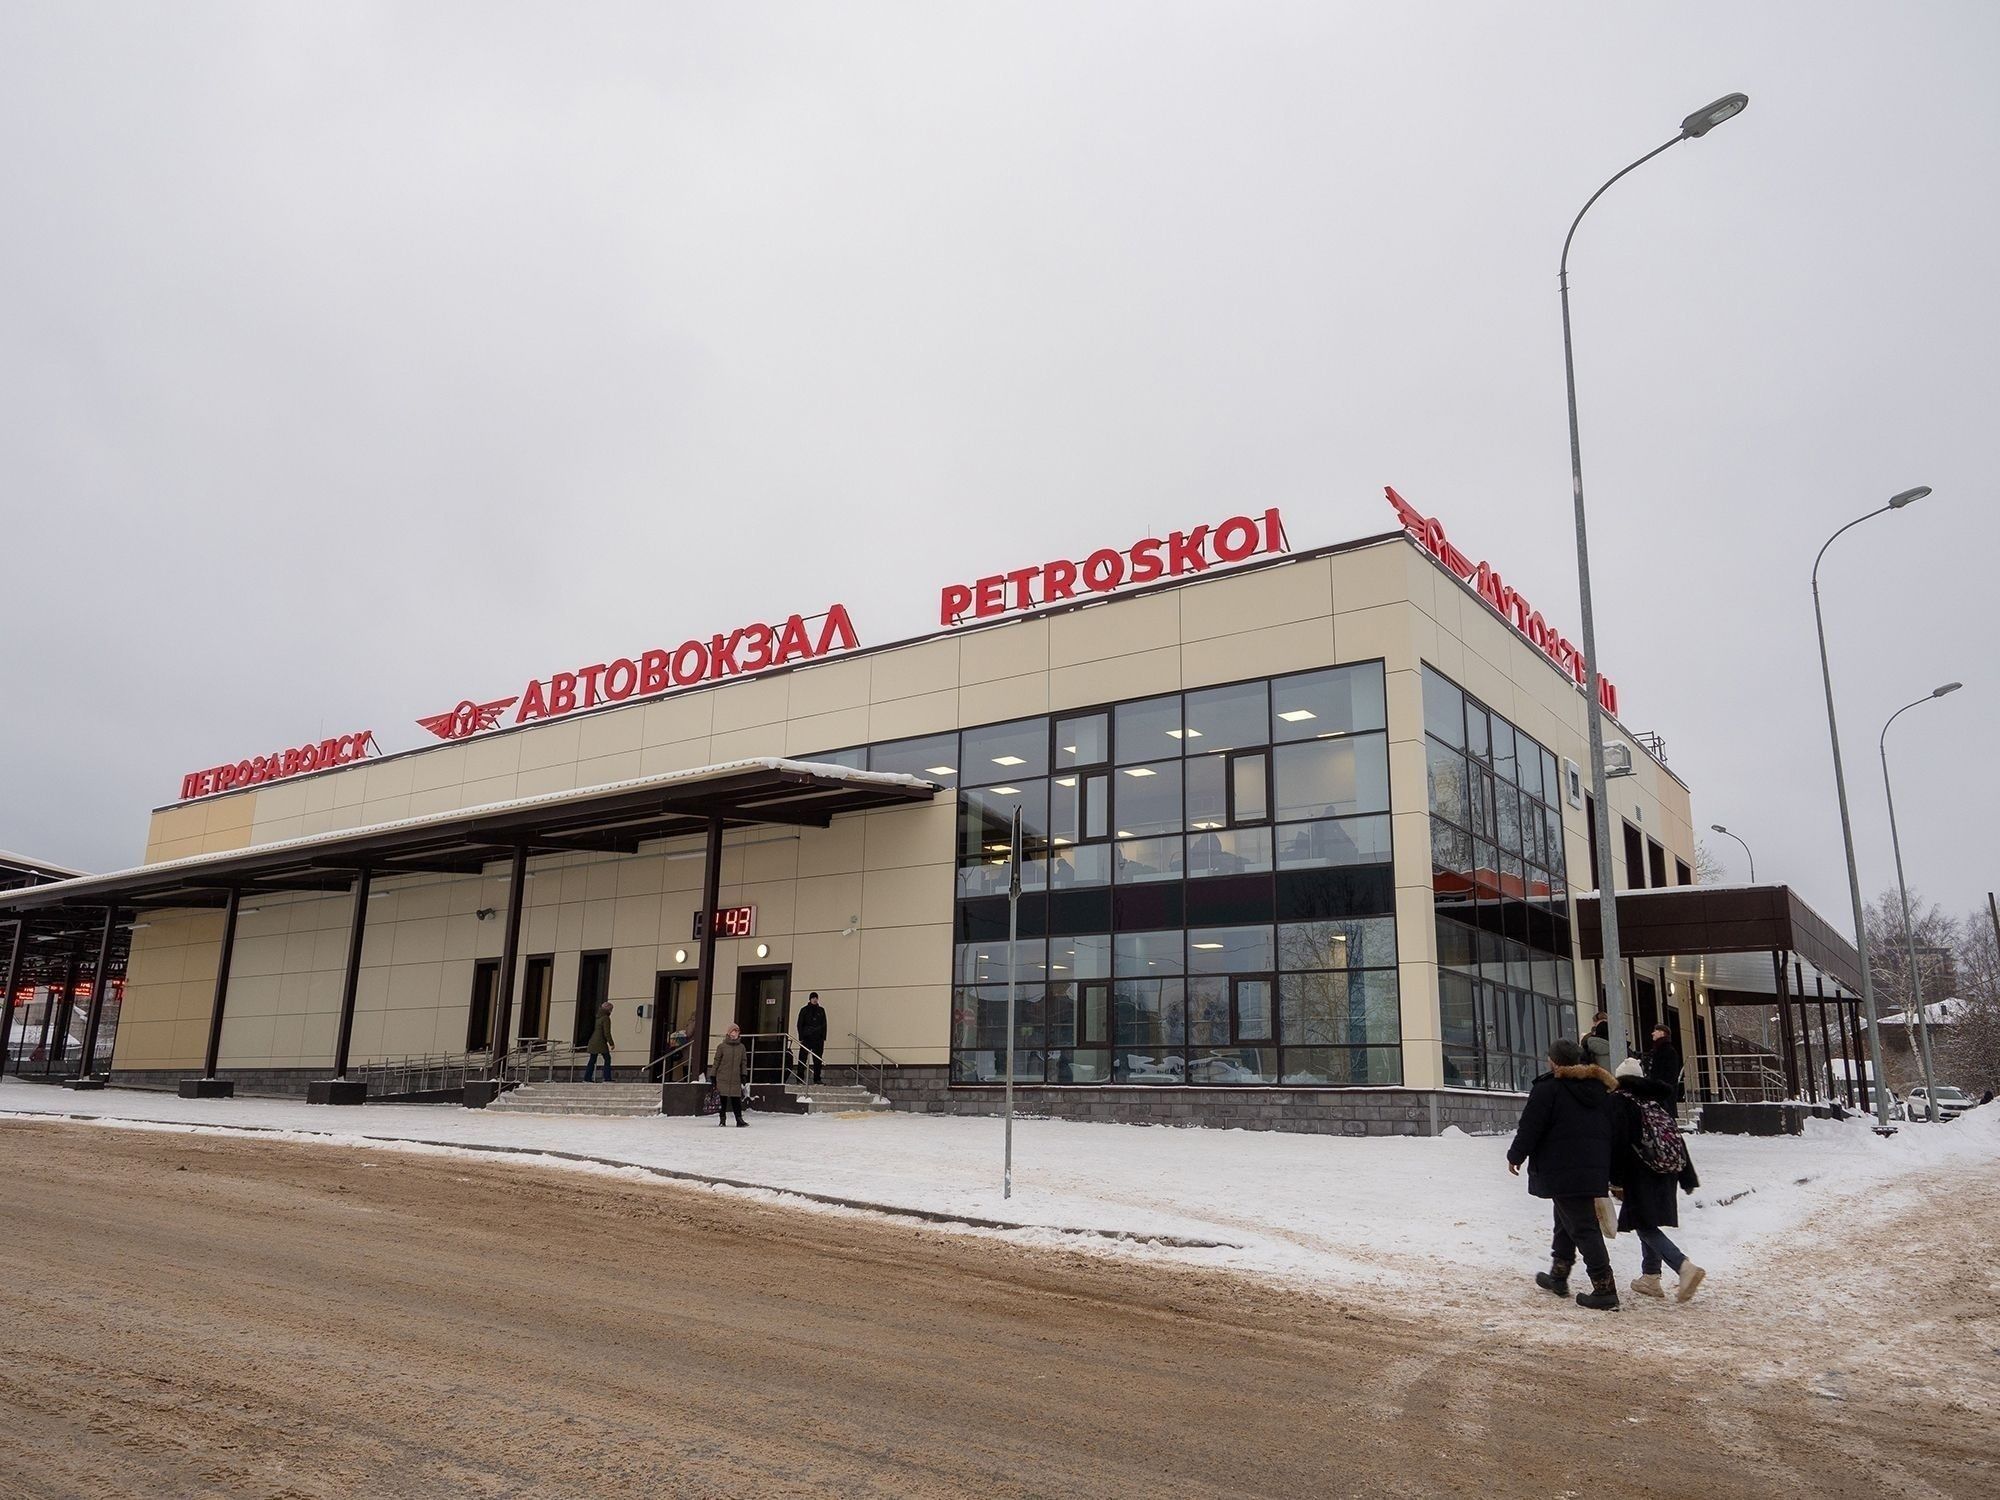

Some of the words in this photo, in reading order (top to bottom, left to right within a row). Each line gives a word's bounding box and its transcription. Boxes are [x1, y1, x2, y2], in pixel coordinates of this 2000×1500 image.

[940, 508, 1280, 626] PETROSKOI
[515, 604, 857, 723] АВТОВОКЗАЛ
[1477, 561, 1618, 718] AVTOAZEU
[180, 730, 372, 800] ПЕТРОЗАВОДСК
